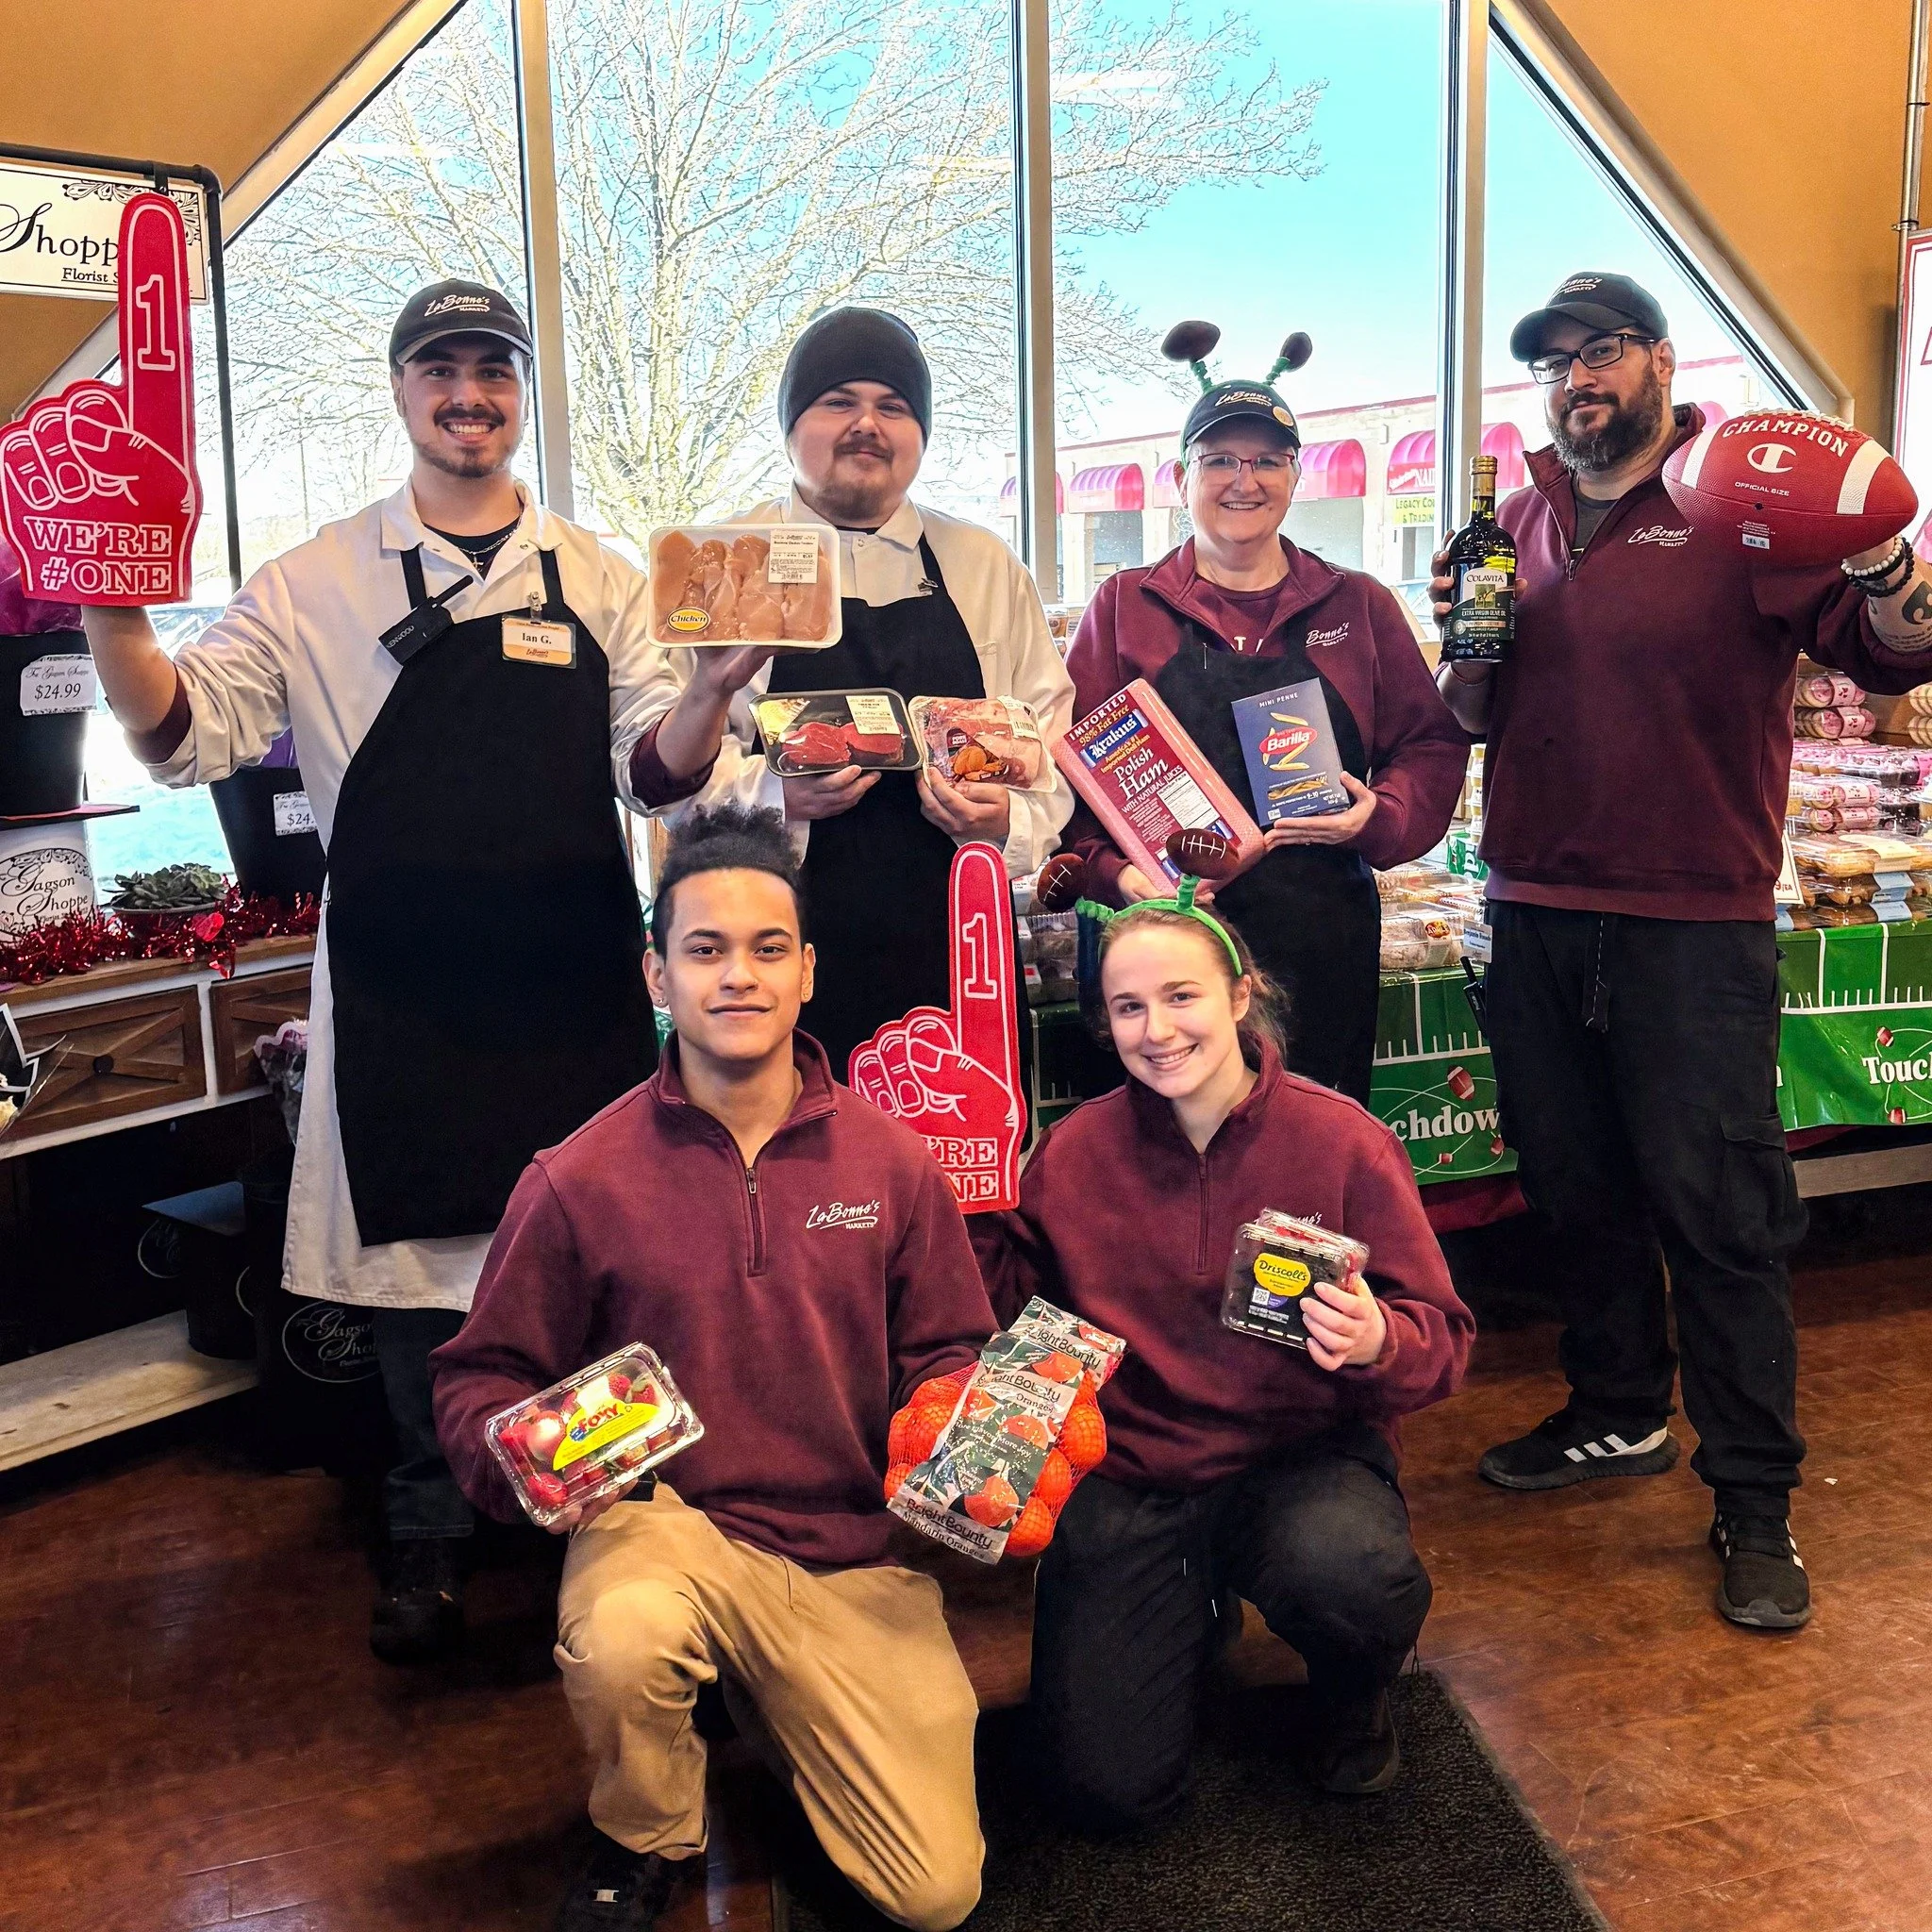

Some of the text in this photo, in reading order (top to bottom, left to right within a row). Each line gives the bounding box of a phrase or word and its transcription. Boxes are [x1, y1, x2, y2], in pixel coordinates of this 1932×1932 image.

[61, 267, 108, 283] Florist
[135, 274, 175, 371] 1
[1722, 419, 1850, 457] CHAMPION
[1396, 499, 1421, 508] LEGACY
[1735, 481, 1790, 496] OFFICIAL SIZE
[24, 516, 172, 558] WE'RE
[41, 557, 172, 594] #ONE
[1466, 575, 1504, 583] COLAVITA
[522, 632, 552, 645] Ian G.
[35, 683, 81, 702] $24.99
[1259, 692, 1298, 708] MINI PENNE
[1069, 693, 1126, 741] IMPORTED
[1079, 705, 1130, 746] 98% Fat Free
[1089, 717, 1138, 758] Krakus
[1267, 731, 1310, 752] Barilla
[1113, 746, 1155, 783] Polish
[1119, 759, 1169, 801] Ham
[1122, 797, 1139, 813] WITH
[1137, 779, 1165, 803] NATURAL
[1163, 765, 1183, 785] JUICES
[1, 861, 75, 896] Gagson
[17, 891, 89, 916] Shoppe
[962, 912, 997, 1000] 1
[1862, 1052, 1932, 1085] Touc
[921, 1135, 998, 1168] 'RE
[806, 1199, 880, 1229] LaBonne's
[1259, 1259, 1307, 1281] Driscoll's
[578, 1403, 619, 1433] FOXY
